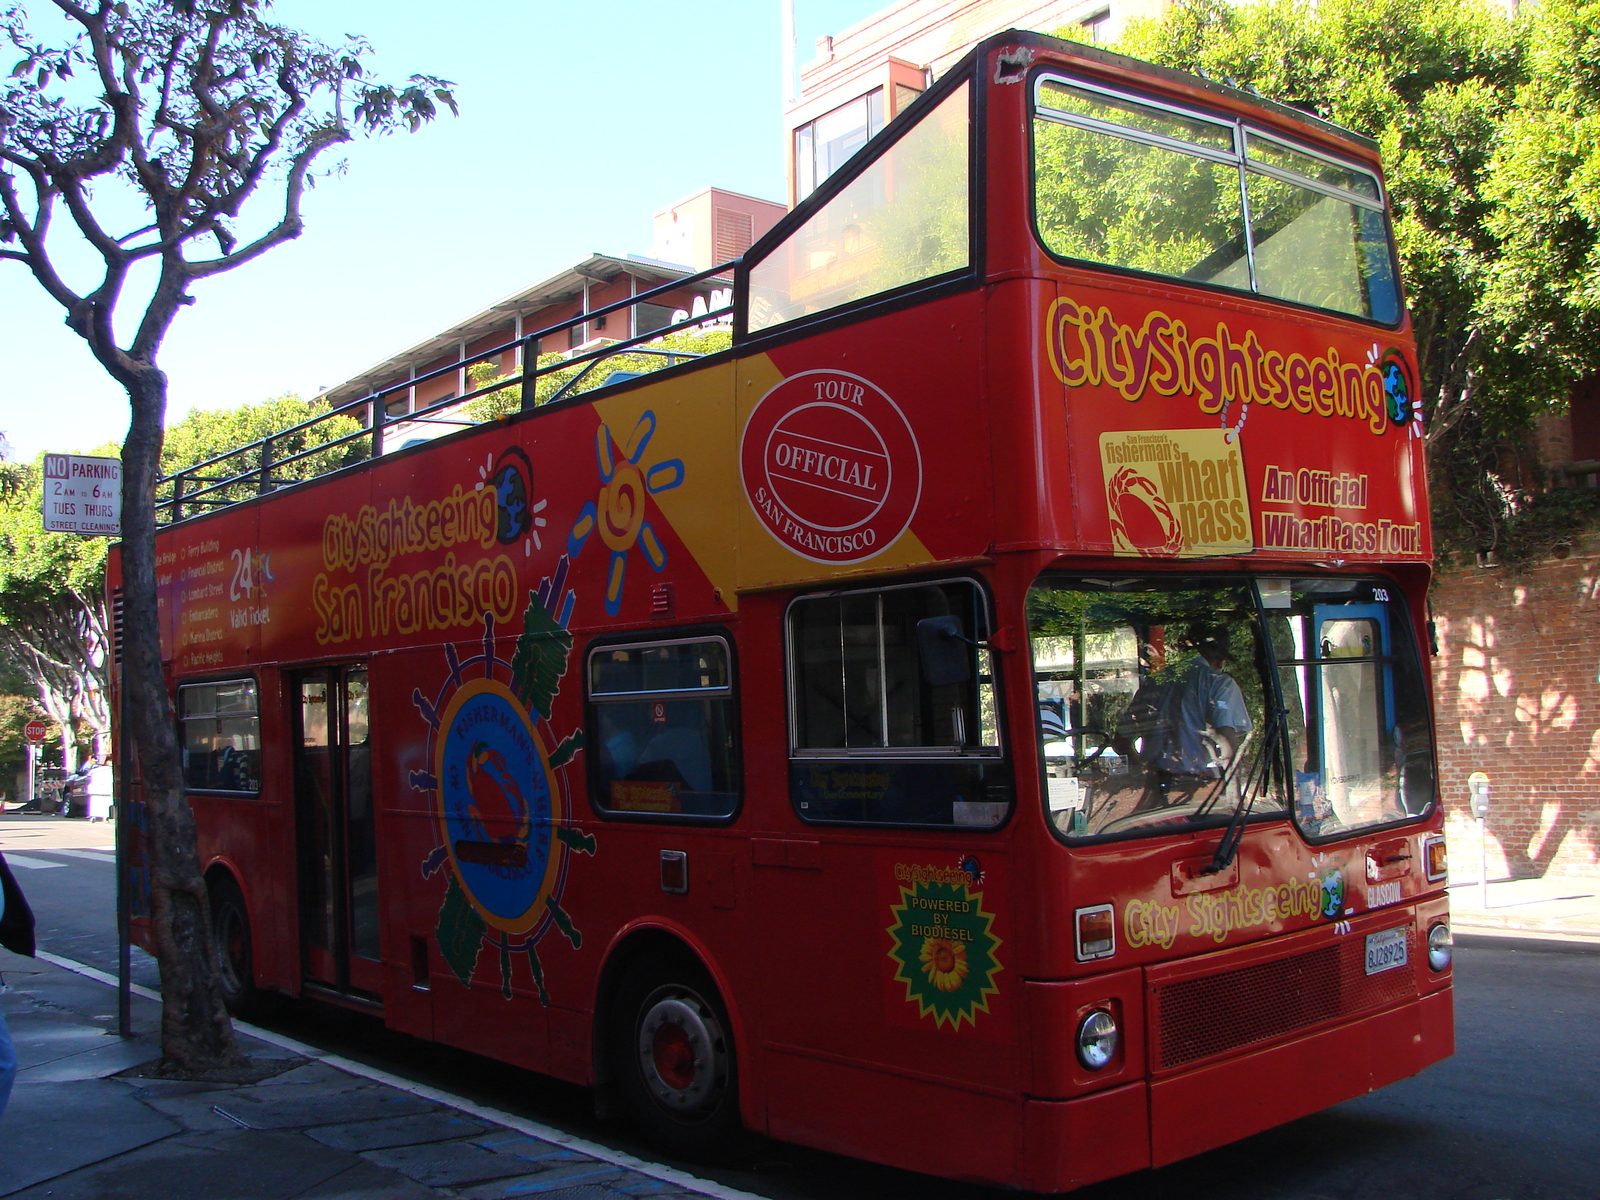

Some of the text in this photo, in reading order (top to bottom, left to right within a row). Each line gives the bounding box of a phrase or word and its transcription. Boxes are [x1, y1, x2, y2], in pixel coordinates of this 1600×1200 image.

[1046, 297, 1386, 434] CitySightseeing
[814, 380, 865, 406] TOUR
[1105, 440, 1180, 464] fisherman's
[1126, 434, 1137, 445] San
[47, 457, 118, 480] NO PARKING
[775, 443, 877, 491] OFFICIAL
[1262, 465, 1367, 509] An Official
[54, 502, 113, 517] TUES THURS
[755, 487, 876, 554] SAN FRANCISCO
[50, 520, 116, 531] STREET CLEANING
[323, 484, 499, 574] CitySightseeing
[1179, 499, 1247, 551] pass
[1261, 511, 1422, 554] Wharf Pass Tour!
[230, 547, 253, 602] 24
[313, 552, 517, 645] San Francisco
[1372, 588, 1388, 601] 203
[27, 726, 45, 735] STOP
[912, 897, 970, 913] POWERED
[1367, 880, 1401, 909] GLASGOW
[933, 913, 949, 925] BY
[1124, 876, 1322, 950] City Sightseeing
[911, 924, 974, 941] BIODIESEL
